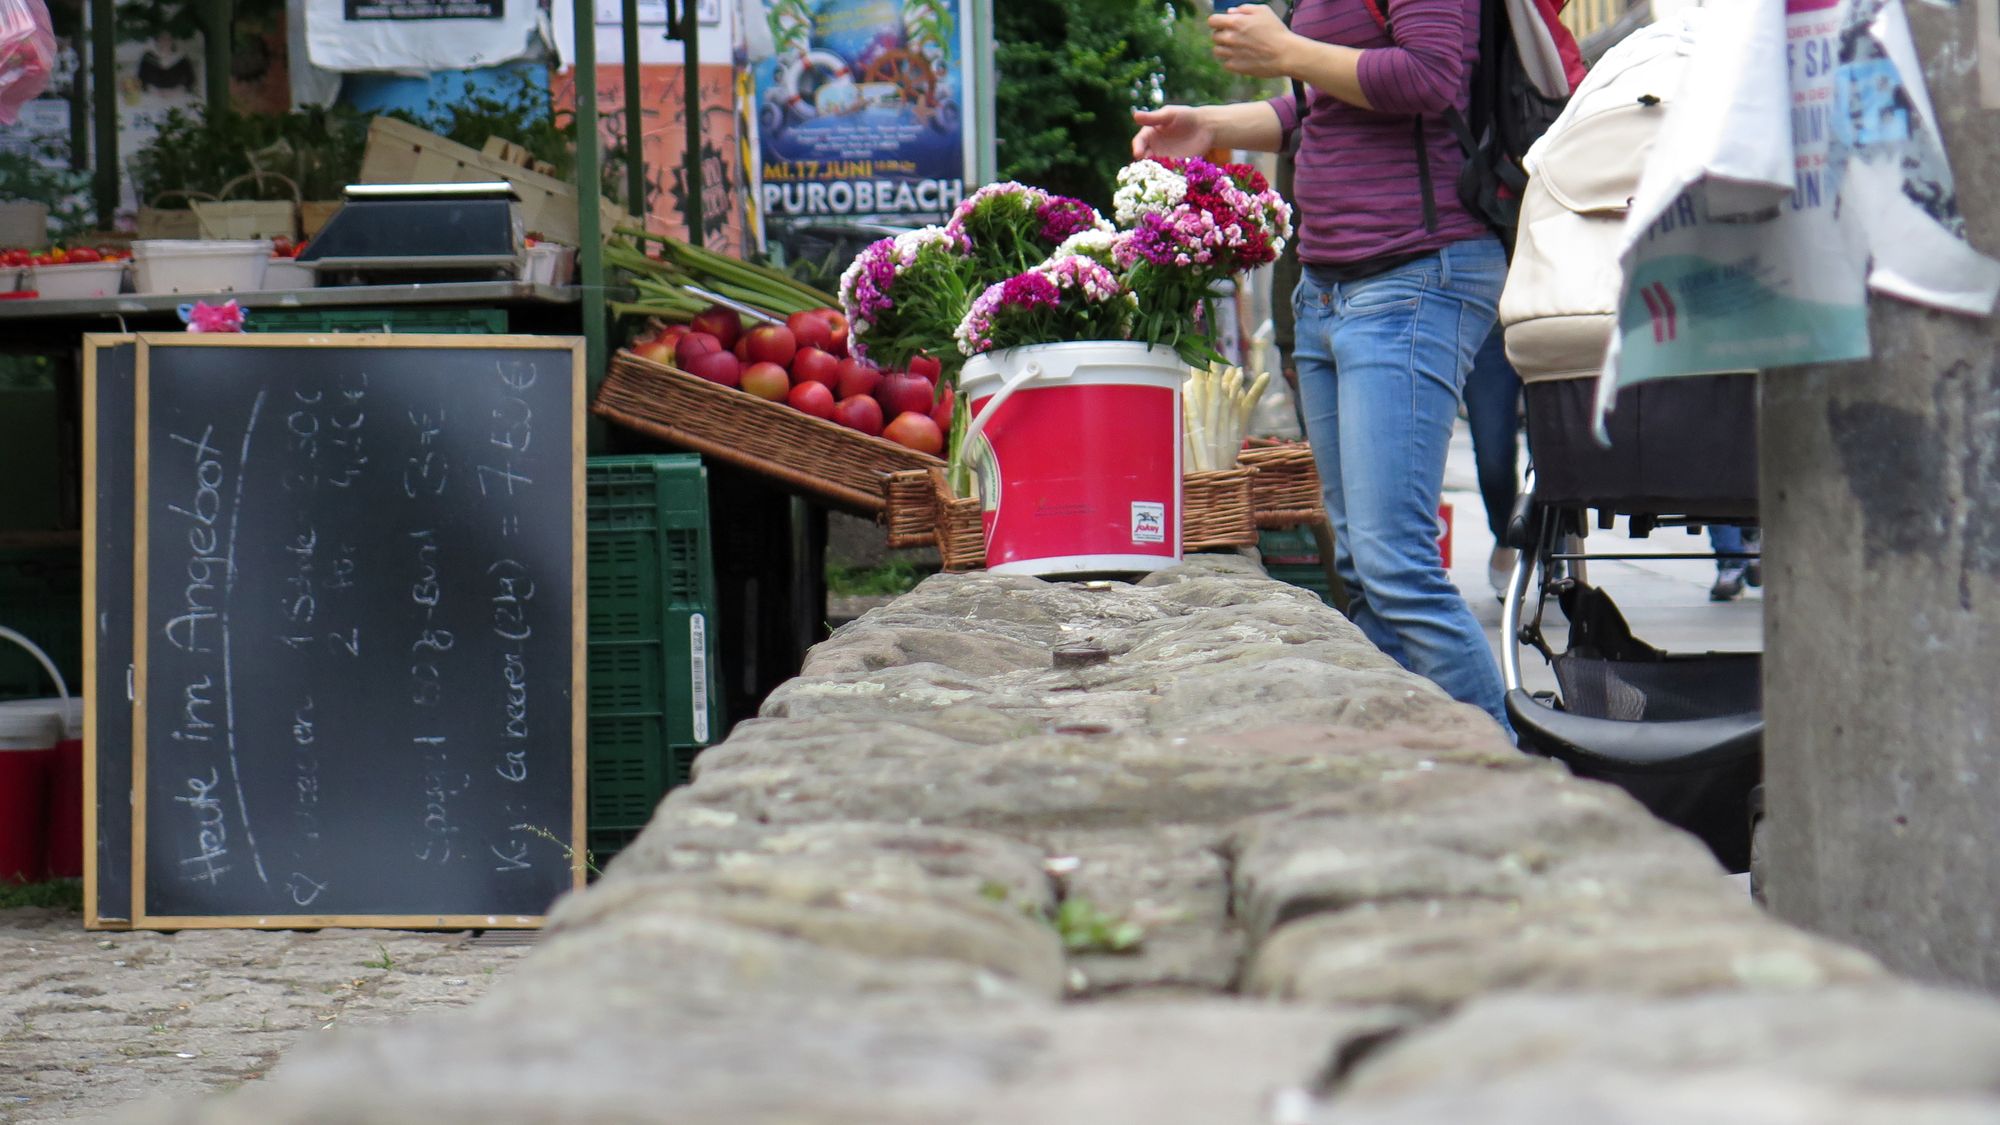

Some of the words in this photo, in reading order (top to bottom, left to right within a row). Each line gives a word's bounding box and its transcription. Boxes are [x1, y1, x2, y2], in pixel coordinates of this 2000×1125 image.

[764, 179, 963, 215] PUROBEACH
[165, 425, 236, 652] Angebot
[328, 628, 358, 656] 2
[171, 675, 216, 741] im
[494, 653, 527, 782] Erbeeren
[174, 767, 232, 885] Heute
[410, 737, 470, 864] Spargl
